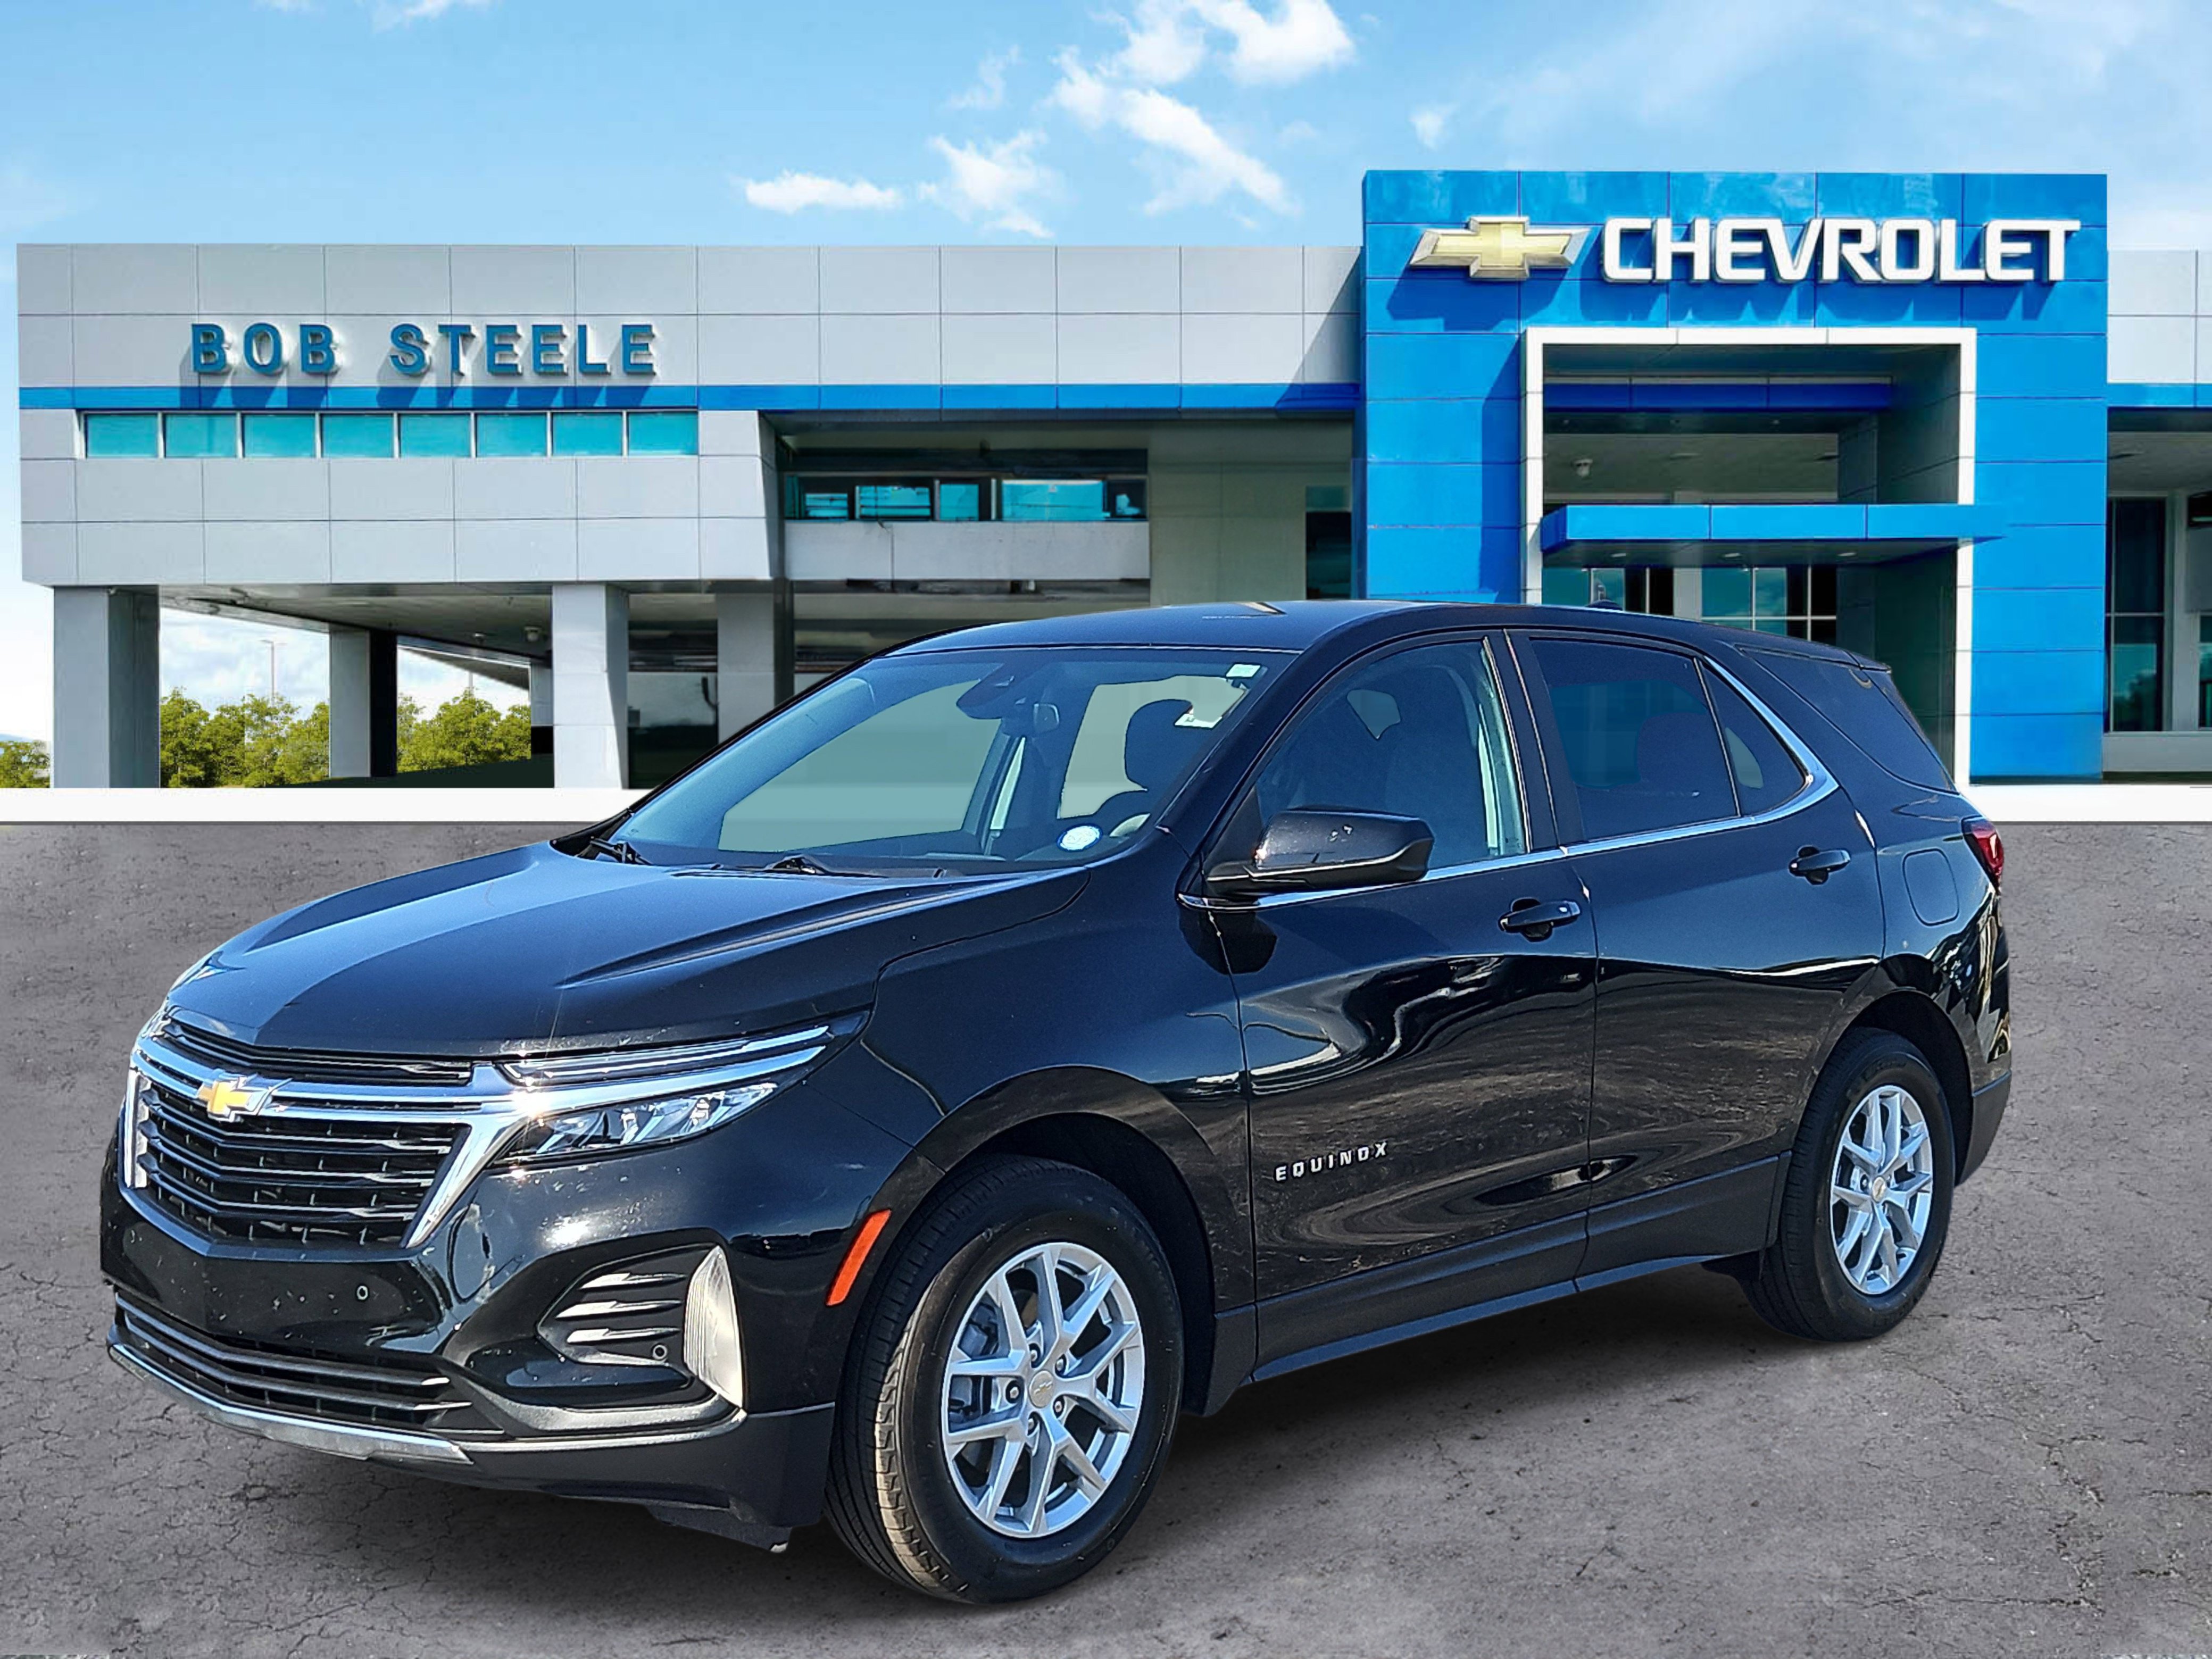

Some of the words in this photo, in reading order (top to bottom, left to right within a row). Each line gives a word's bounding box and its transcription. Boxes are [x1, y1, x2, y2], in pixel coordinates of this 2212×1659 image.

[1601, 218, 2081, 283] CHEVROLET
[191, 323, 339, 374] BOB
[390, 323, 655, 375] STEELE
[1275, 1141, 1387, 1181] EQUINOX
